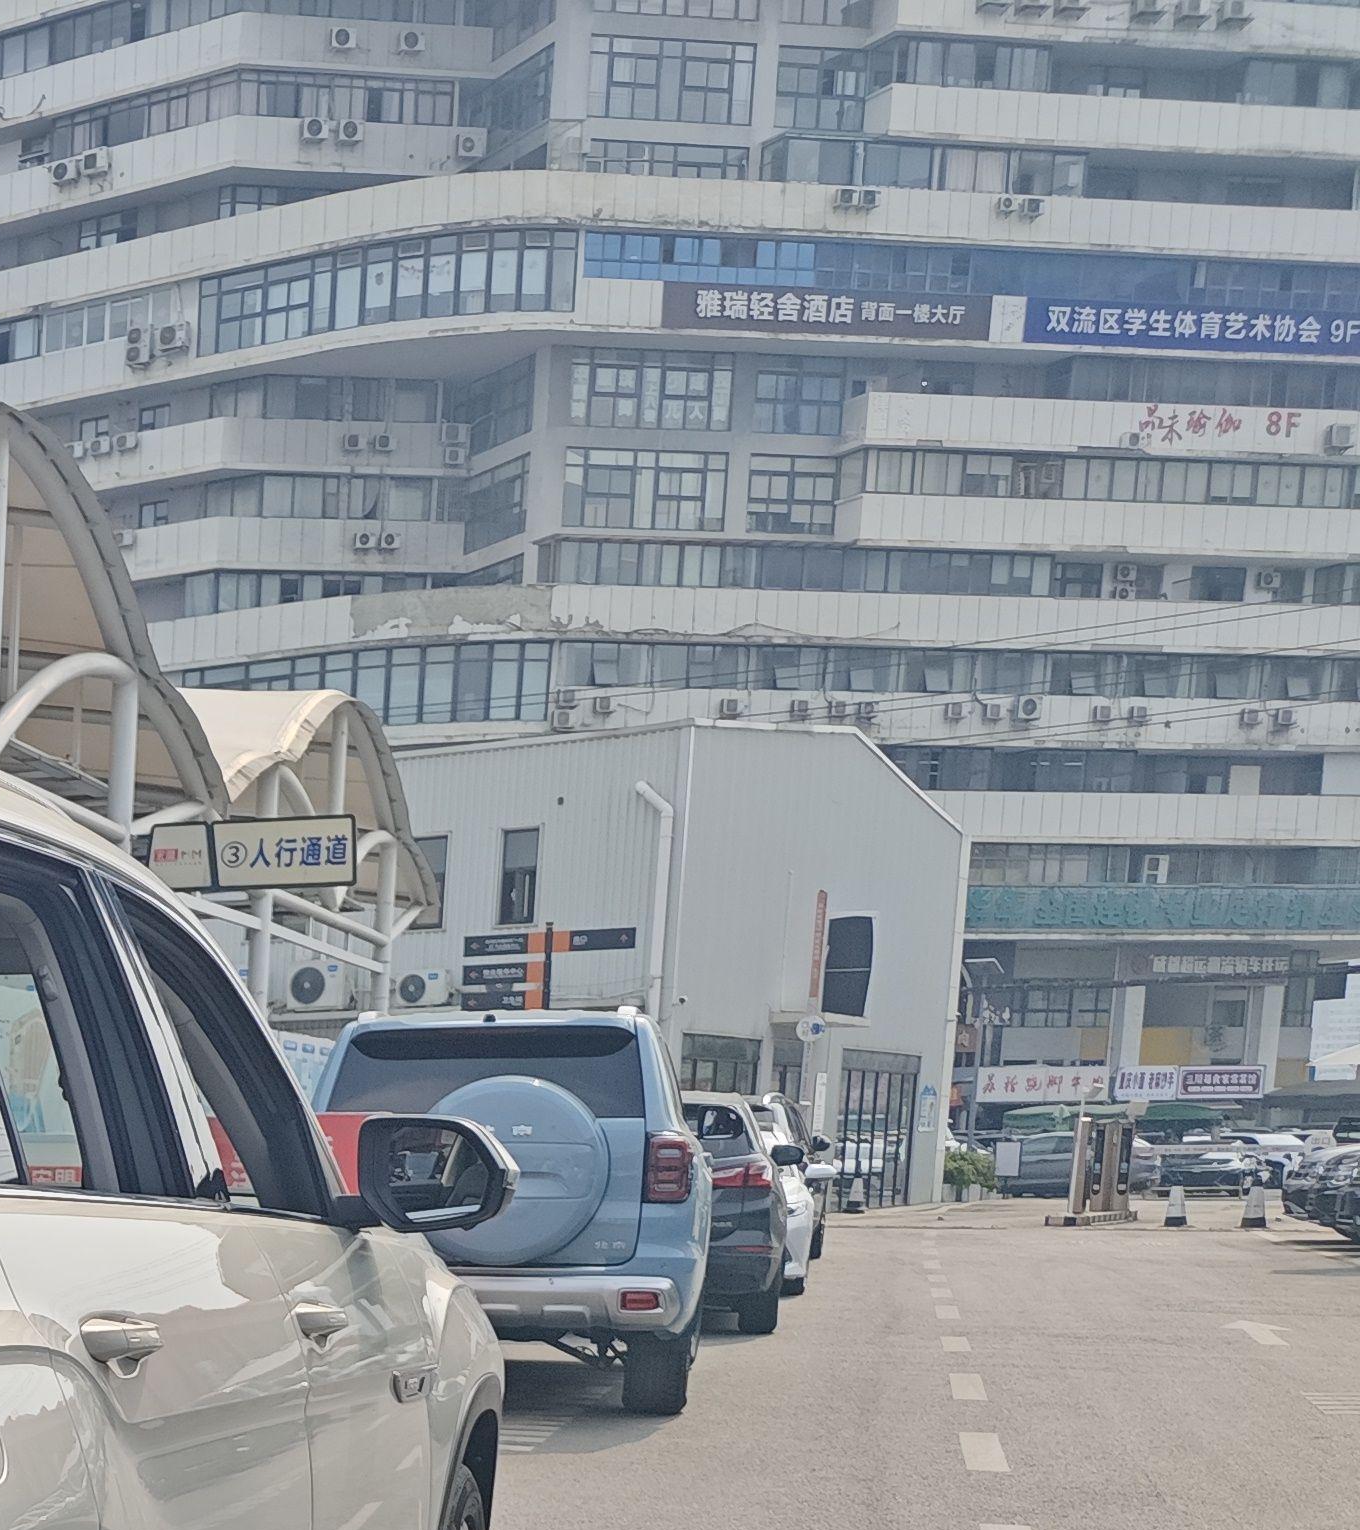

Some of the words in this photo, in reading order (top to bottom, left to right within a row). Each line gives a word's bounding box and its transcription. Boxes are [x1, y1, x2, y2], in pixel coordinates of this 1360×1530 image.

[696, 289, 855, 323] 雅瑞轻舍酒店
[860, 301, 966, 324] 背面一楼大厅
[1046, 305, 1322, 343] 双流区学生体育艺术协会
[1266, 411, 1301, 438] 8F
